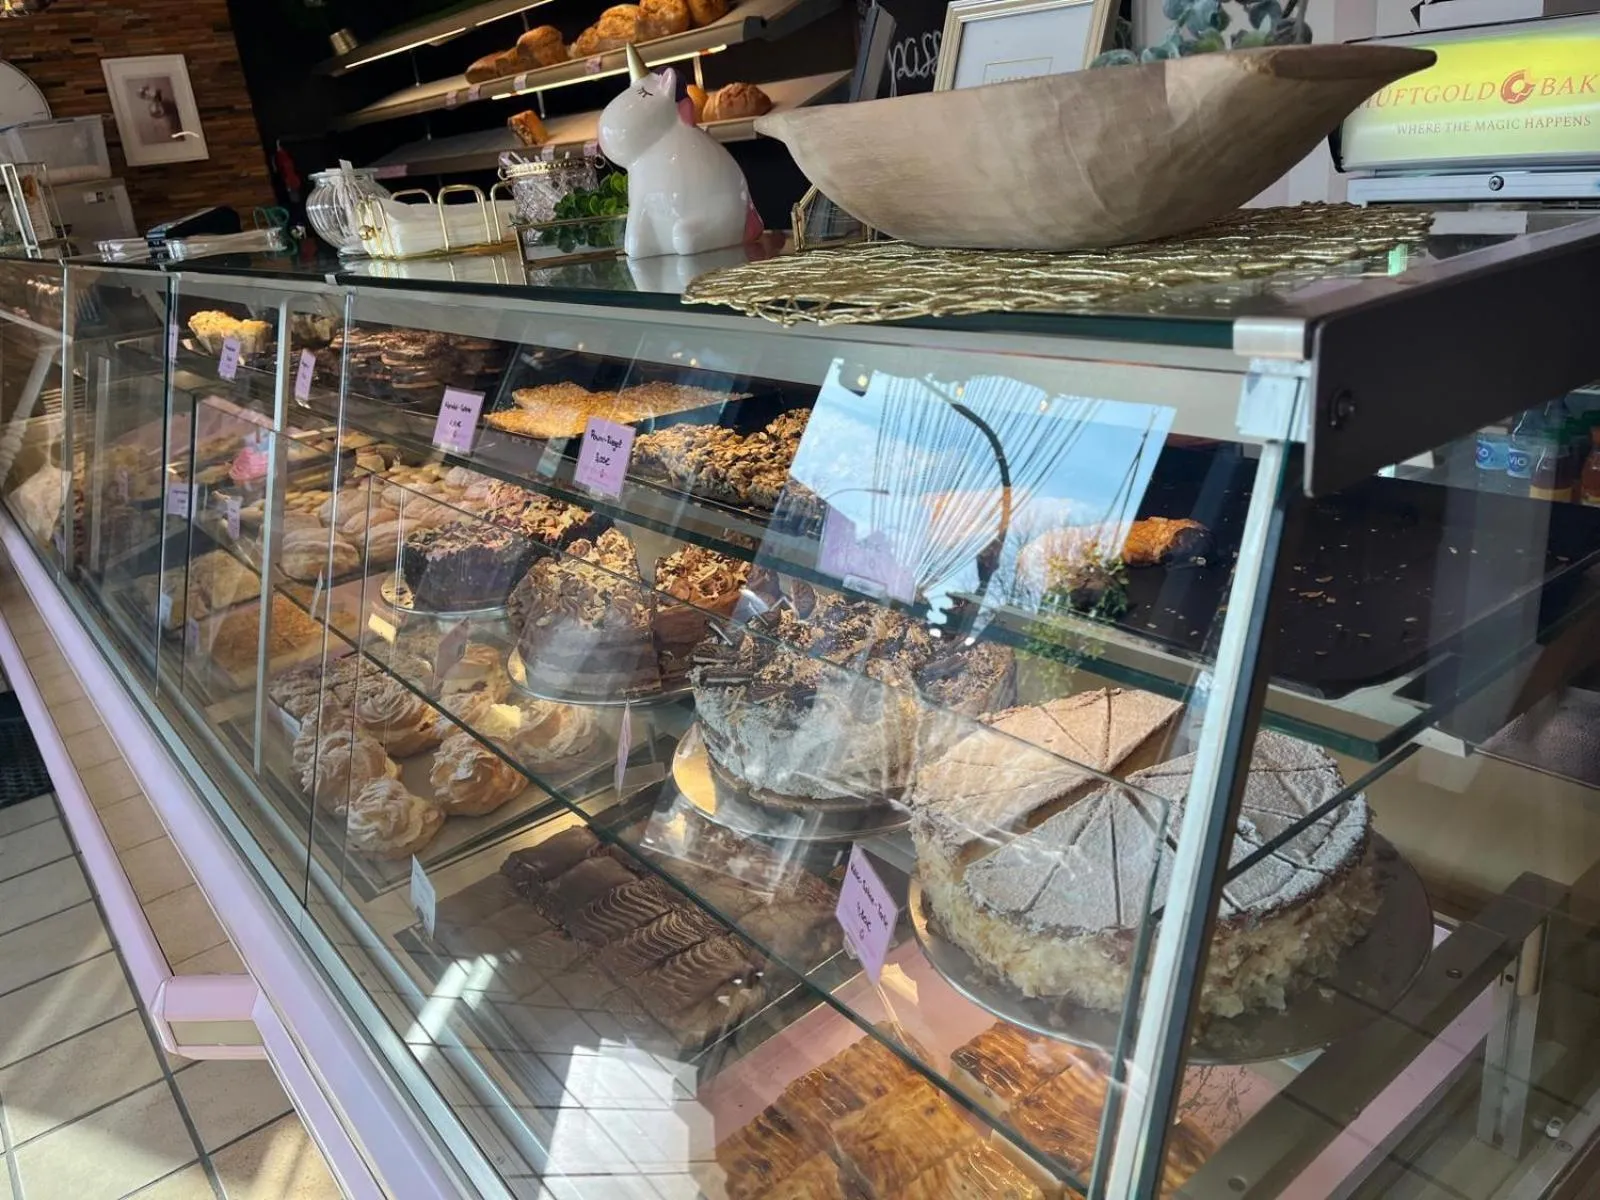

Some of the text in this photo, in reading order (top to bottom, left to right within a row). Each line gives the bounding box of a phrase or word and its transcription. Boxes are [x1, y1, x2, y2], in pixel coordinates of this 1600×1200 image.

[1397, 115, 1591, 135] WHERE THE MAGIC HAPPENS
